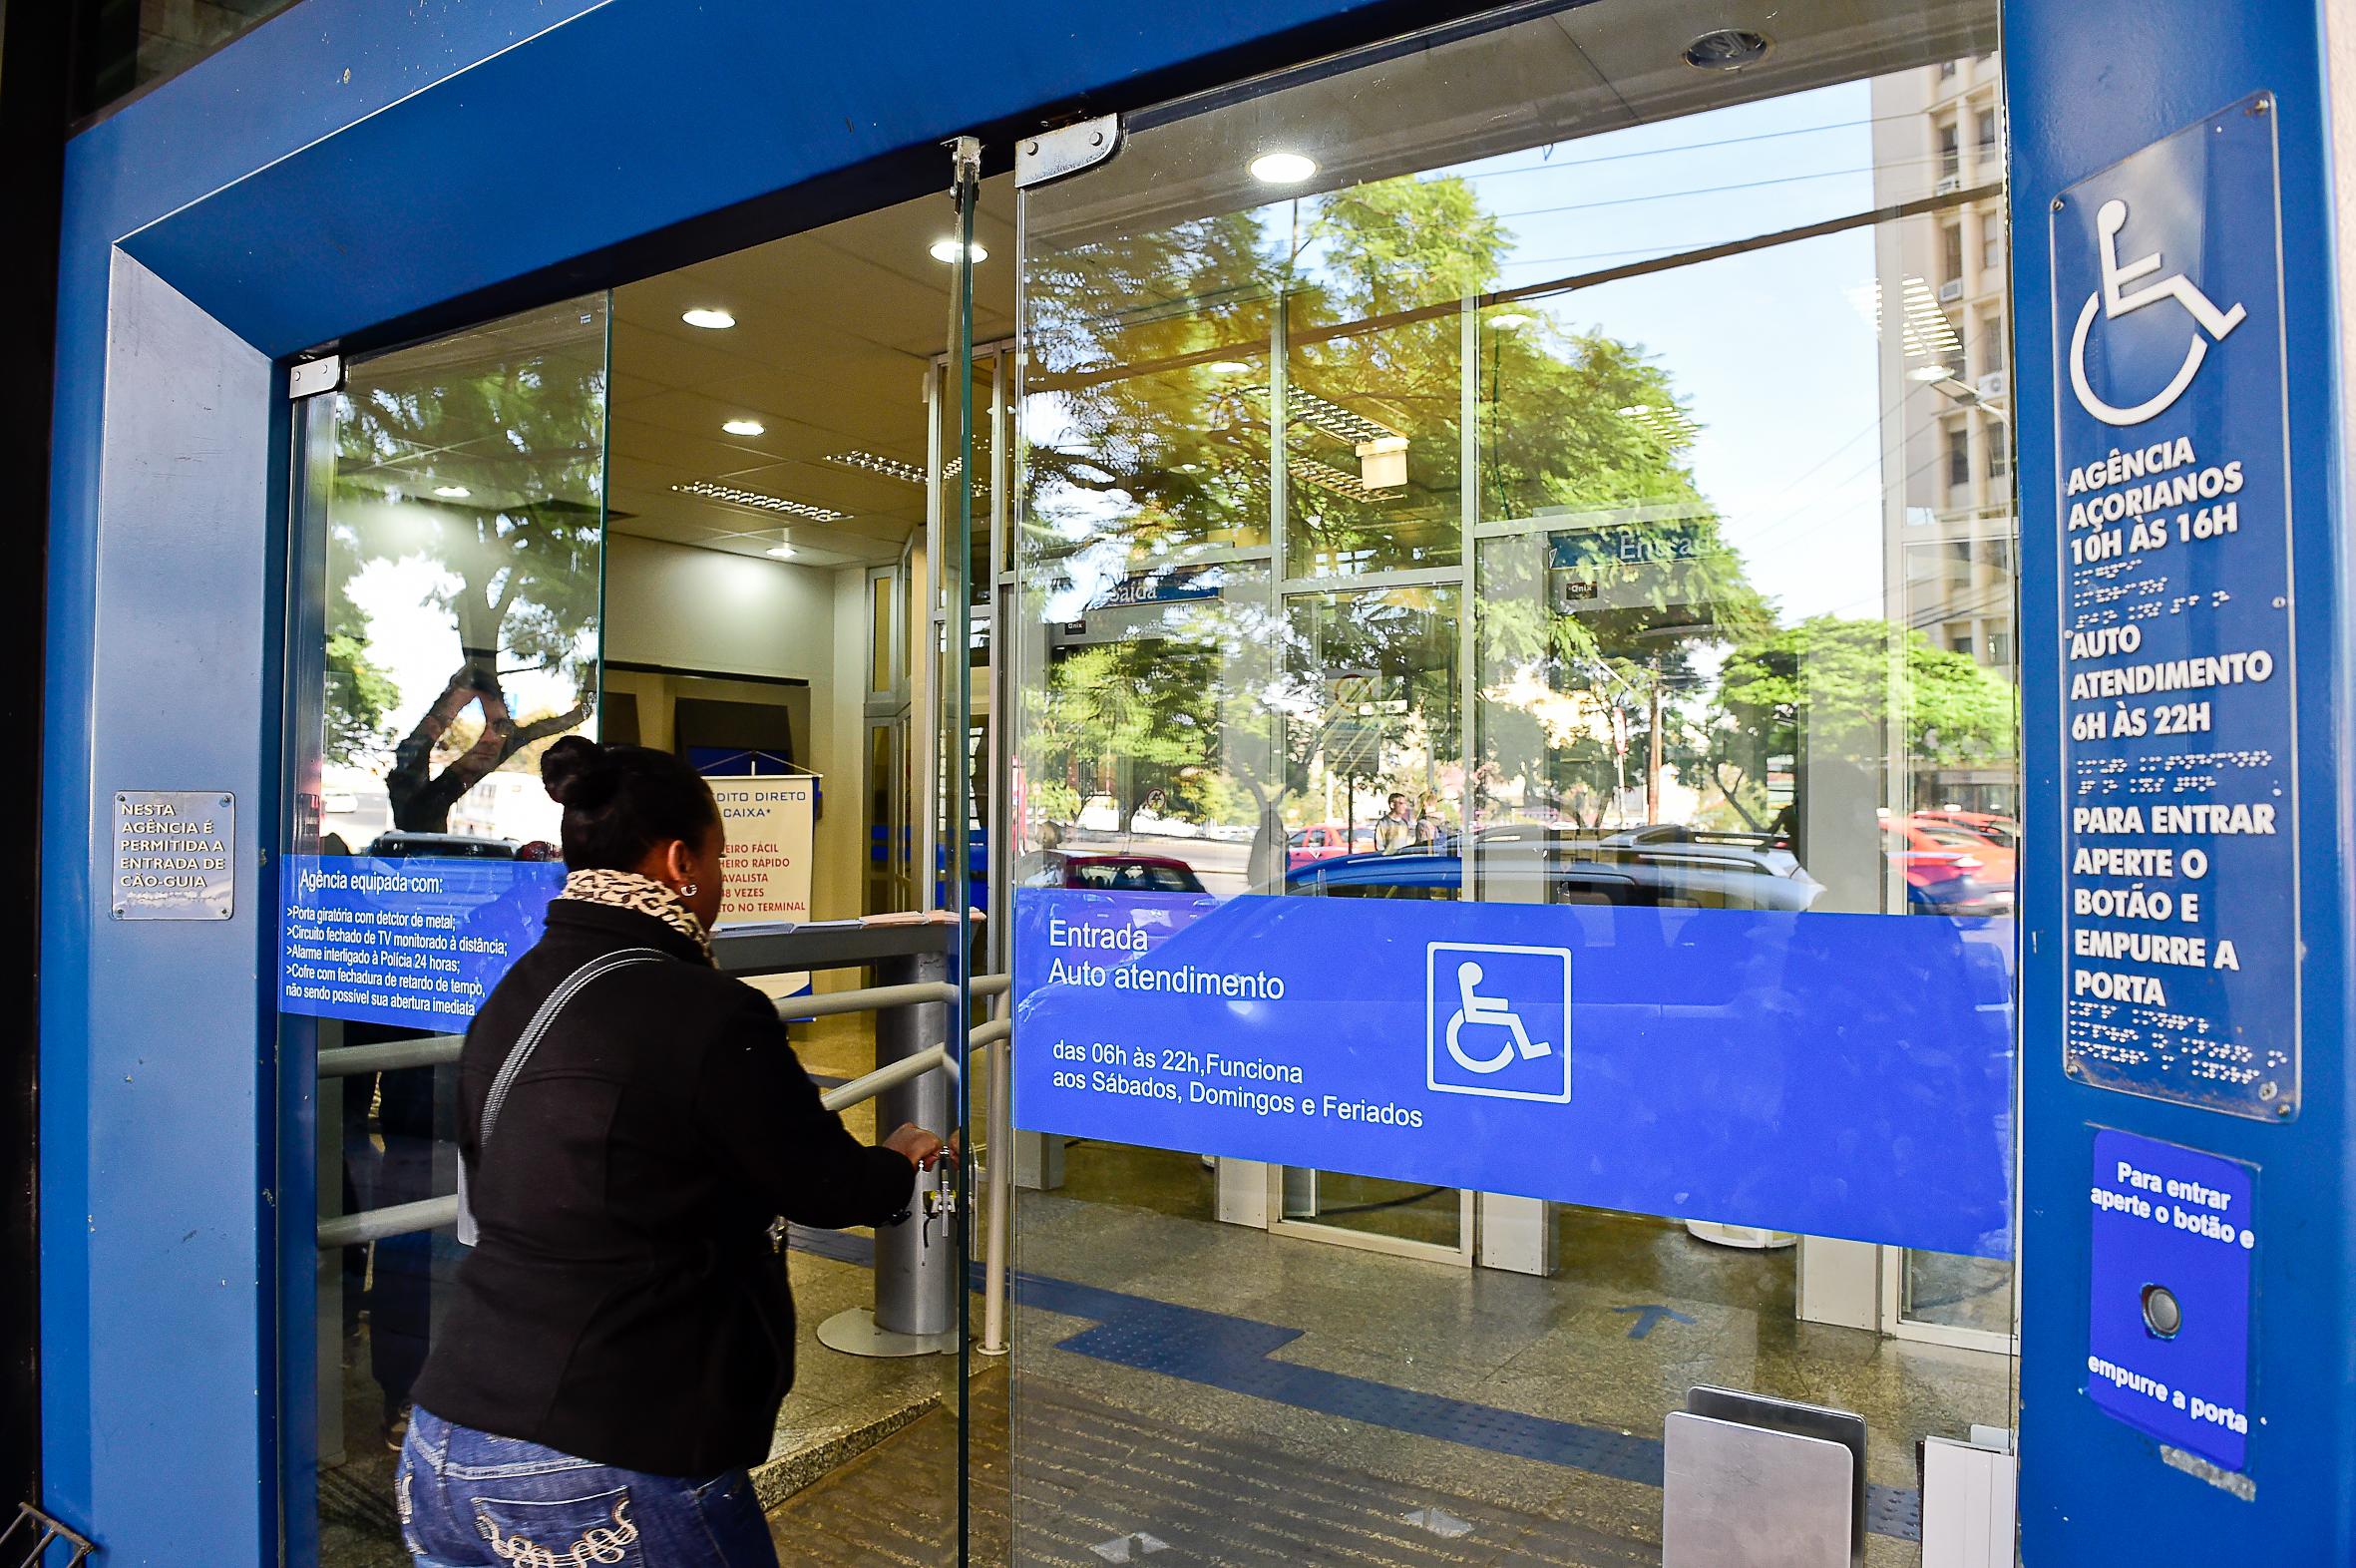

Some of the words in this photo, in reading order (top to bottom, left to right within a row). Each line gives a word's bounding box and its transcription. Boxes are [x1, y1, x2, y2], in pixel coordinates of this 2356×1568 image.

[2068, 437, 2196, 497] AGÊNCIA
[2068, 460, 2244, 533] AÇORIANOS
[2070, 528, 2123, 566] 10H
[2129, 515, 2167, 555] ÀS
[2176, 502, 2238, 542] 16H
[2070, 623, 2142, 660] AUTO
[2071, 649, 2273, 700] ATENDIMENTO
[2071, 710, 2106, 742] 6H
[2112, 700, 2149, 737] ÀS
[2154, 701, 2210, 737] 22H
[121, 804, 176, 816] NESTA
[716, 792, 749, 802] DITO
[755, 791, 806, 802] DIRETO
[122, 819, 199, 834] AGÊNCIA
[203, 819, 214, 834] É
[2073, 805, 2145, 835] PARA
[2152, 803, 2276, 836] ENTRAR
[121, 840, 208, 852] PERMITIDA
[212, 840, 224, 852] A
[725, 844, 749, 854] EIRO
[751, 841, 779, 854] FÁCIL
[120, 858, 199, 870] ENTRADA
[203, 858, 225, 871] DE
[720, 858, 749, 868] HEIRO
[752, 856, 790, 868] RÁPIDO
[2073, 848, 2172, 878] APERTE
[2181, 849, 2208, 880] O
[120, 873, 207, 888] CÃO-GUIA
[299, 869, 348, 894] Agência
[350, 873, 408, 895] equipada
[411, 877, 444, 894] com:
[721, 874, 768, 883] AVALISTA
[734, 887, 764, 898] VEZES
[718, 903, 735, 913] TO
[738, 903, 754, 913] NO
[757, 902, 806, 912] TERMINAL
[2074, 883, 2173, 922] BOTÃO
[2181, 893, 2199, 923] E
[317, 907, 353, 925] giratória
[354, 911, 374, 924] com
[376, 910, 409, 927] detctor
[411, 912, 423, 928] de
[426, 914, 456, 932] metal;
[1048, 919, 1149, 951] Entrada
[326, 928, 362, 944] fechado
[364, 929, 376, 945] de
[378, 930, 392, 946] TV
[393, 933, 447, 951] monitorado
[450, 935, 457, 952] à
[459, 936, 508, 958] distância;
[2075, 929, 2205, 970] EMPURRE
[2213, 940, 2240, 972] A
[324, 947, 370, 967] interligado
[372, 950, 379, 966] à
[380, 951, 412, 968] Polícia
[414, 953, 427, 970] 24
[429, 955, 461, 975] horas;
[317, 969, 336, 981] com
[337, 968, 383, 985] fechadura
[384, 972, 397, 987] de
[399, 974, 433, 990] retardo
[435, 977, 449, 991] de
[451, 979, 486, 998] tempo,
[1047, 957, 1106, 987] Auto
[1114, 963, 1285, 999] atendimento
[2075, 969, 2166, 1006] PORTA
[285, 982, 302, 997] não
[303, 985, 331, 1000] sendo
[332, 988, 370, 1005] possível
[371, 993, 389, 1007] sua
[390, 993, 430, 1011] abertura
[1052, 1038, 1086, 1061] das
[1091, 1042, 1127, 1066] 06h
[1132, 1046, 1157, 1069] às
[1052, 1070, 1086, 1089] aos
[1091, 1070, 1183, 1104] Sábados,
[1189, 1081, 1296, 1116] Domingos
[1301, 1097, 1316, 1116] e
[1322, 1094, 1423, 1128] Feriados
[2117, 1161, 2162, 1193] Para
[2165, 1176, 2231, 1212] entrar
[2091, 1186, 2151, 1220] aperte
[2155, 1204, 2169, 1225] o
[2173, 1206, 2235, 1245] botão
[2239, 1229, 2255, 1250] e
[2088, 1355, 2168, 1402] empurre
[2172, 1388, 2186, 1410] a
[2190, 1394, 2248, 1435] porta
